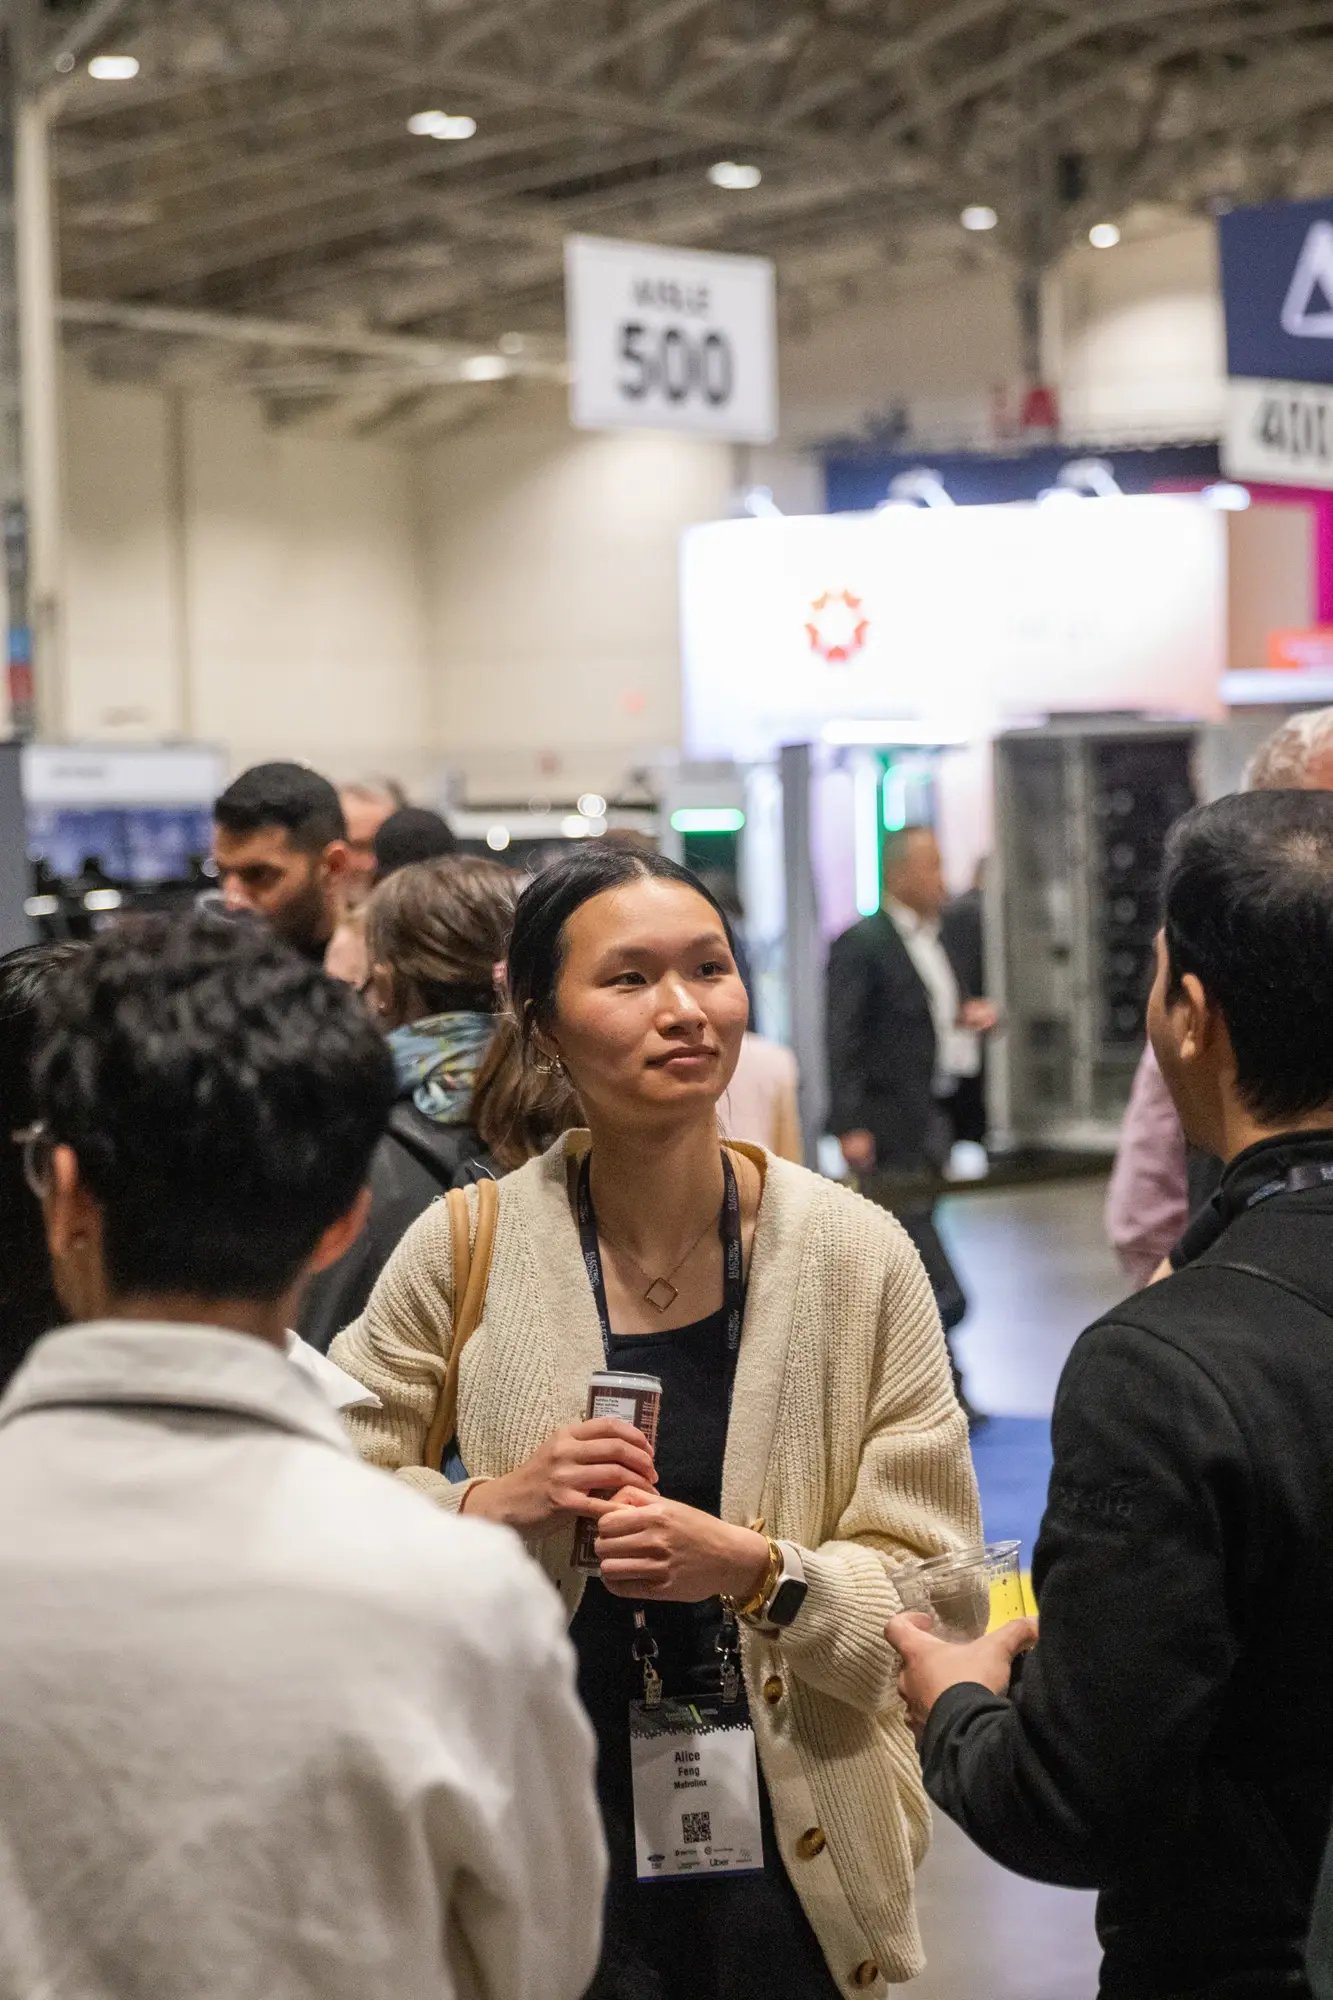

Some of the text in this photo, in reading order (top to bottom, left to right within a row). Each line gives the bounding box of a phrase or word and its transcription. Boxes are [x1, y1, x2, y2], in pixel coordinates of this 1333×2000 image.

[619, 320, 733, 406] 500
[600, 1320, 609, 1354] ELECTRIC
[674, 1751, 700, 1763] Alice
[678, 1767, 700, 1777] Feng
